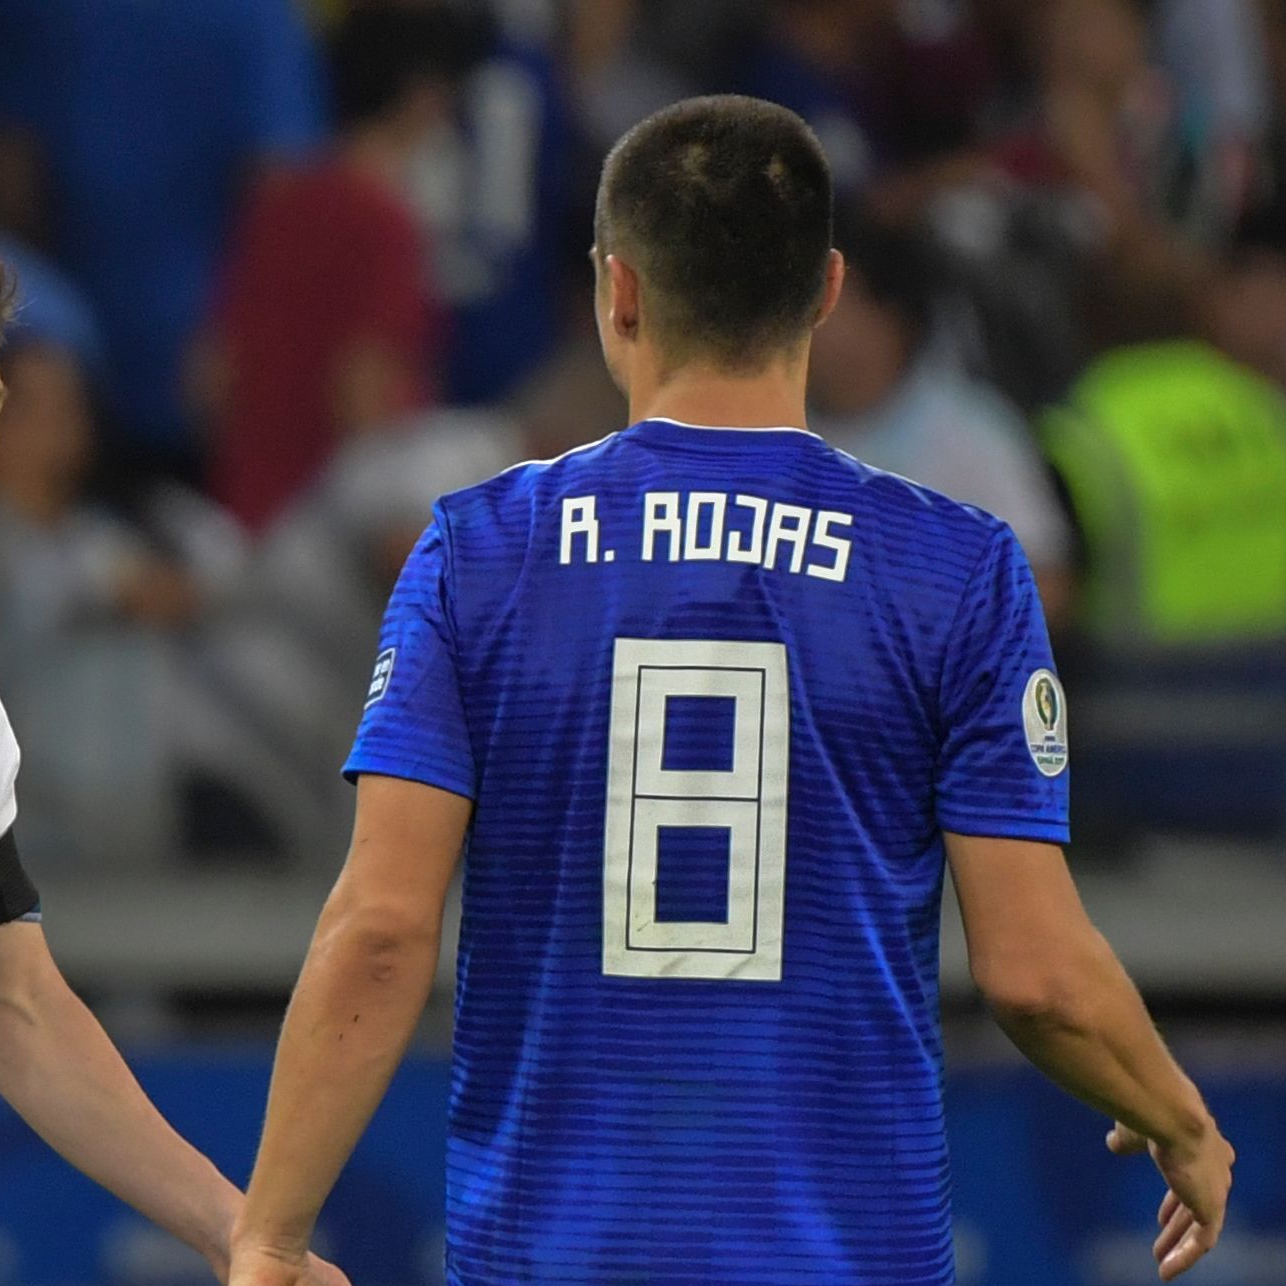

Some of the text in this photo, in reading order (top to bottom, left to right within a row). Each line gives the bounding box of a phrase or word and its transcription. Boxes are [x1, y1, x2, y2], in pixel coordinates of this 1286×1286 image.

[559, 491, 853, 582] R. ROJAS
[602, 637, 790, 981] 8
